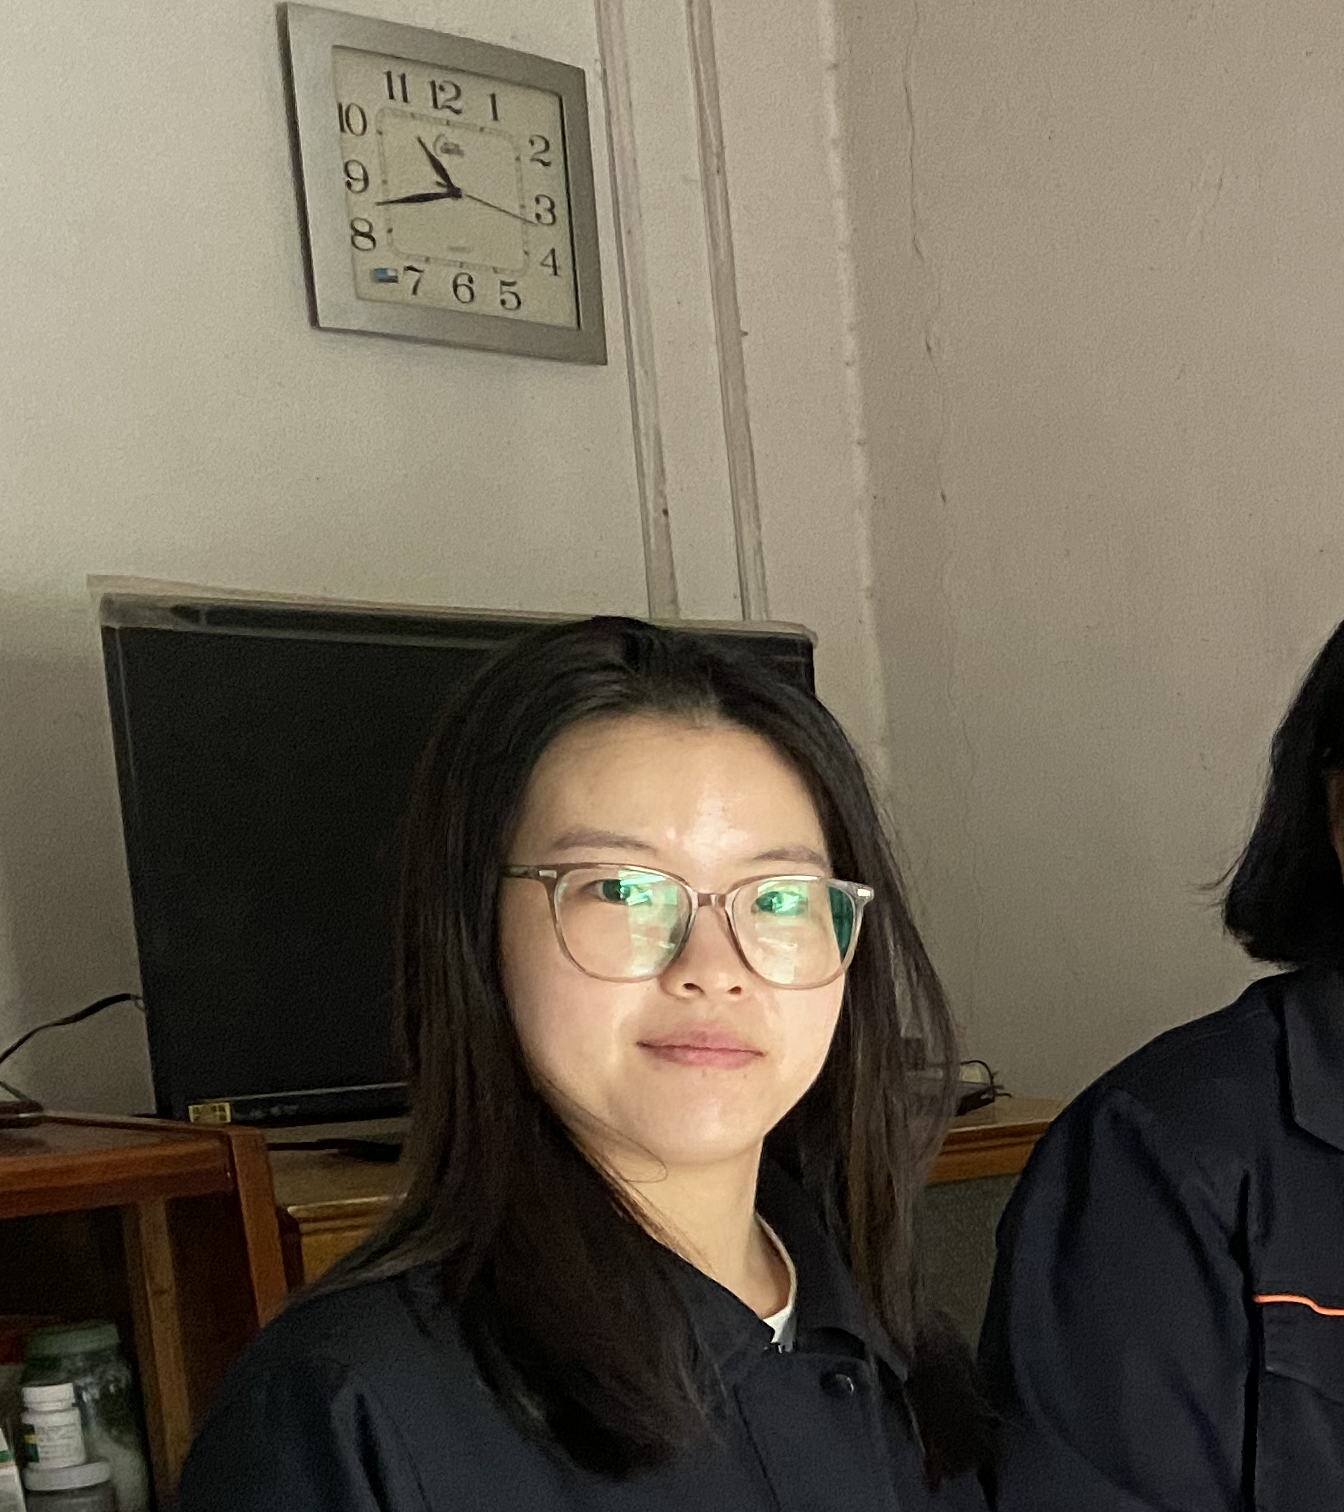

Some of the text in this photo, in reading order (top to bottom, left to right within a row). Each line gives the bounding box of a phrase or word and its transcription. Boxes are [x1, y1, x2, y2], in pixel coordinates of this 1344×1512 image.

[383, 70, 409, 104] 11
[429, 79, 464, 116] 12
[337, 102, 368, 137] 10
[488, 92, 499, 121] 1
[528, 134, 553, 167] 2
[344, 159, 370, 194] 9
[534, 194, 557, 227] 3
[350, 217, 377, 252] 8
[540, 247, 562, 277] 4
[402, 265, 425, 297] 7
[452, 272, 475, 304] 6
[499, 280, 522, 311] 5
